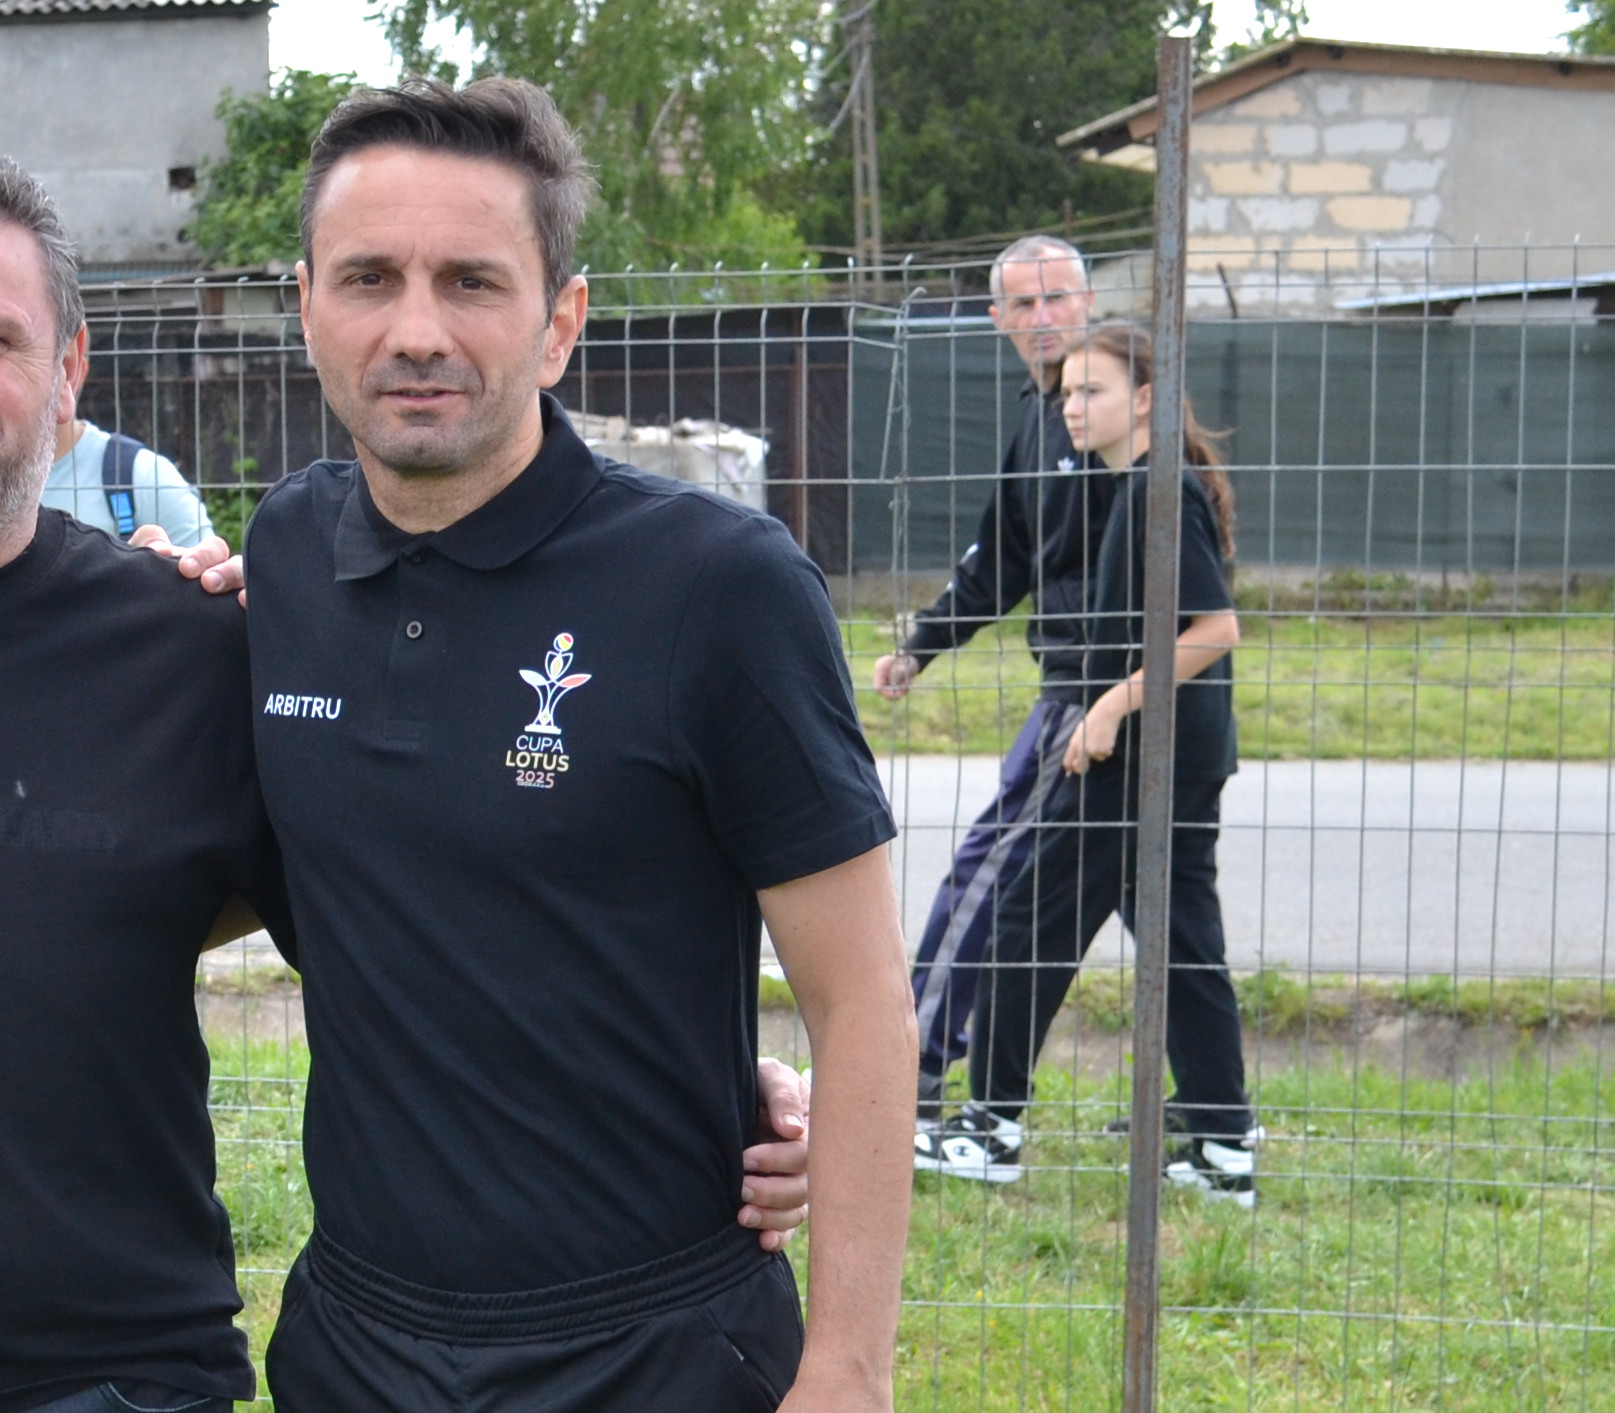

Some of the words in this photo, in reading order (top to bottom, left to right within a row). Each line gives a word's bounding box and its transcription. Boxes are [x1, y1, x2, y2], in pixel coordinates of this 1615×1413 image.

[264, 692, 342, 720] ARBITRU
[516, 734, 565, 754] CUPA
[505, 749, 570, 773] LOTUS
[515, 769, 556, 789] 2025
